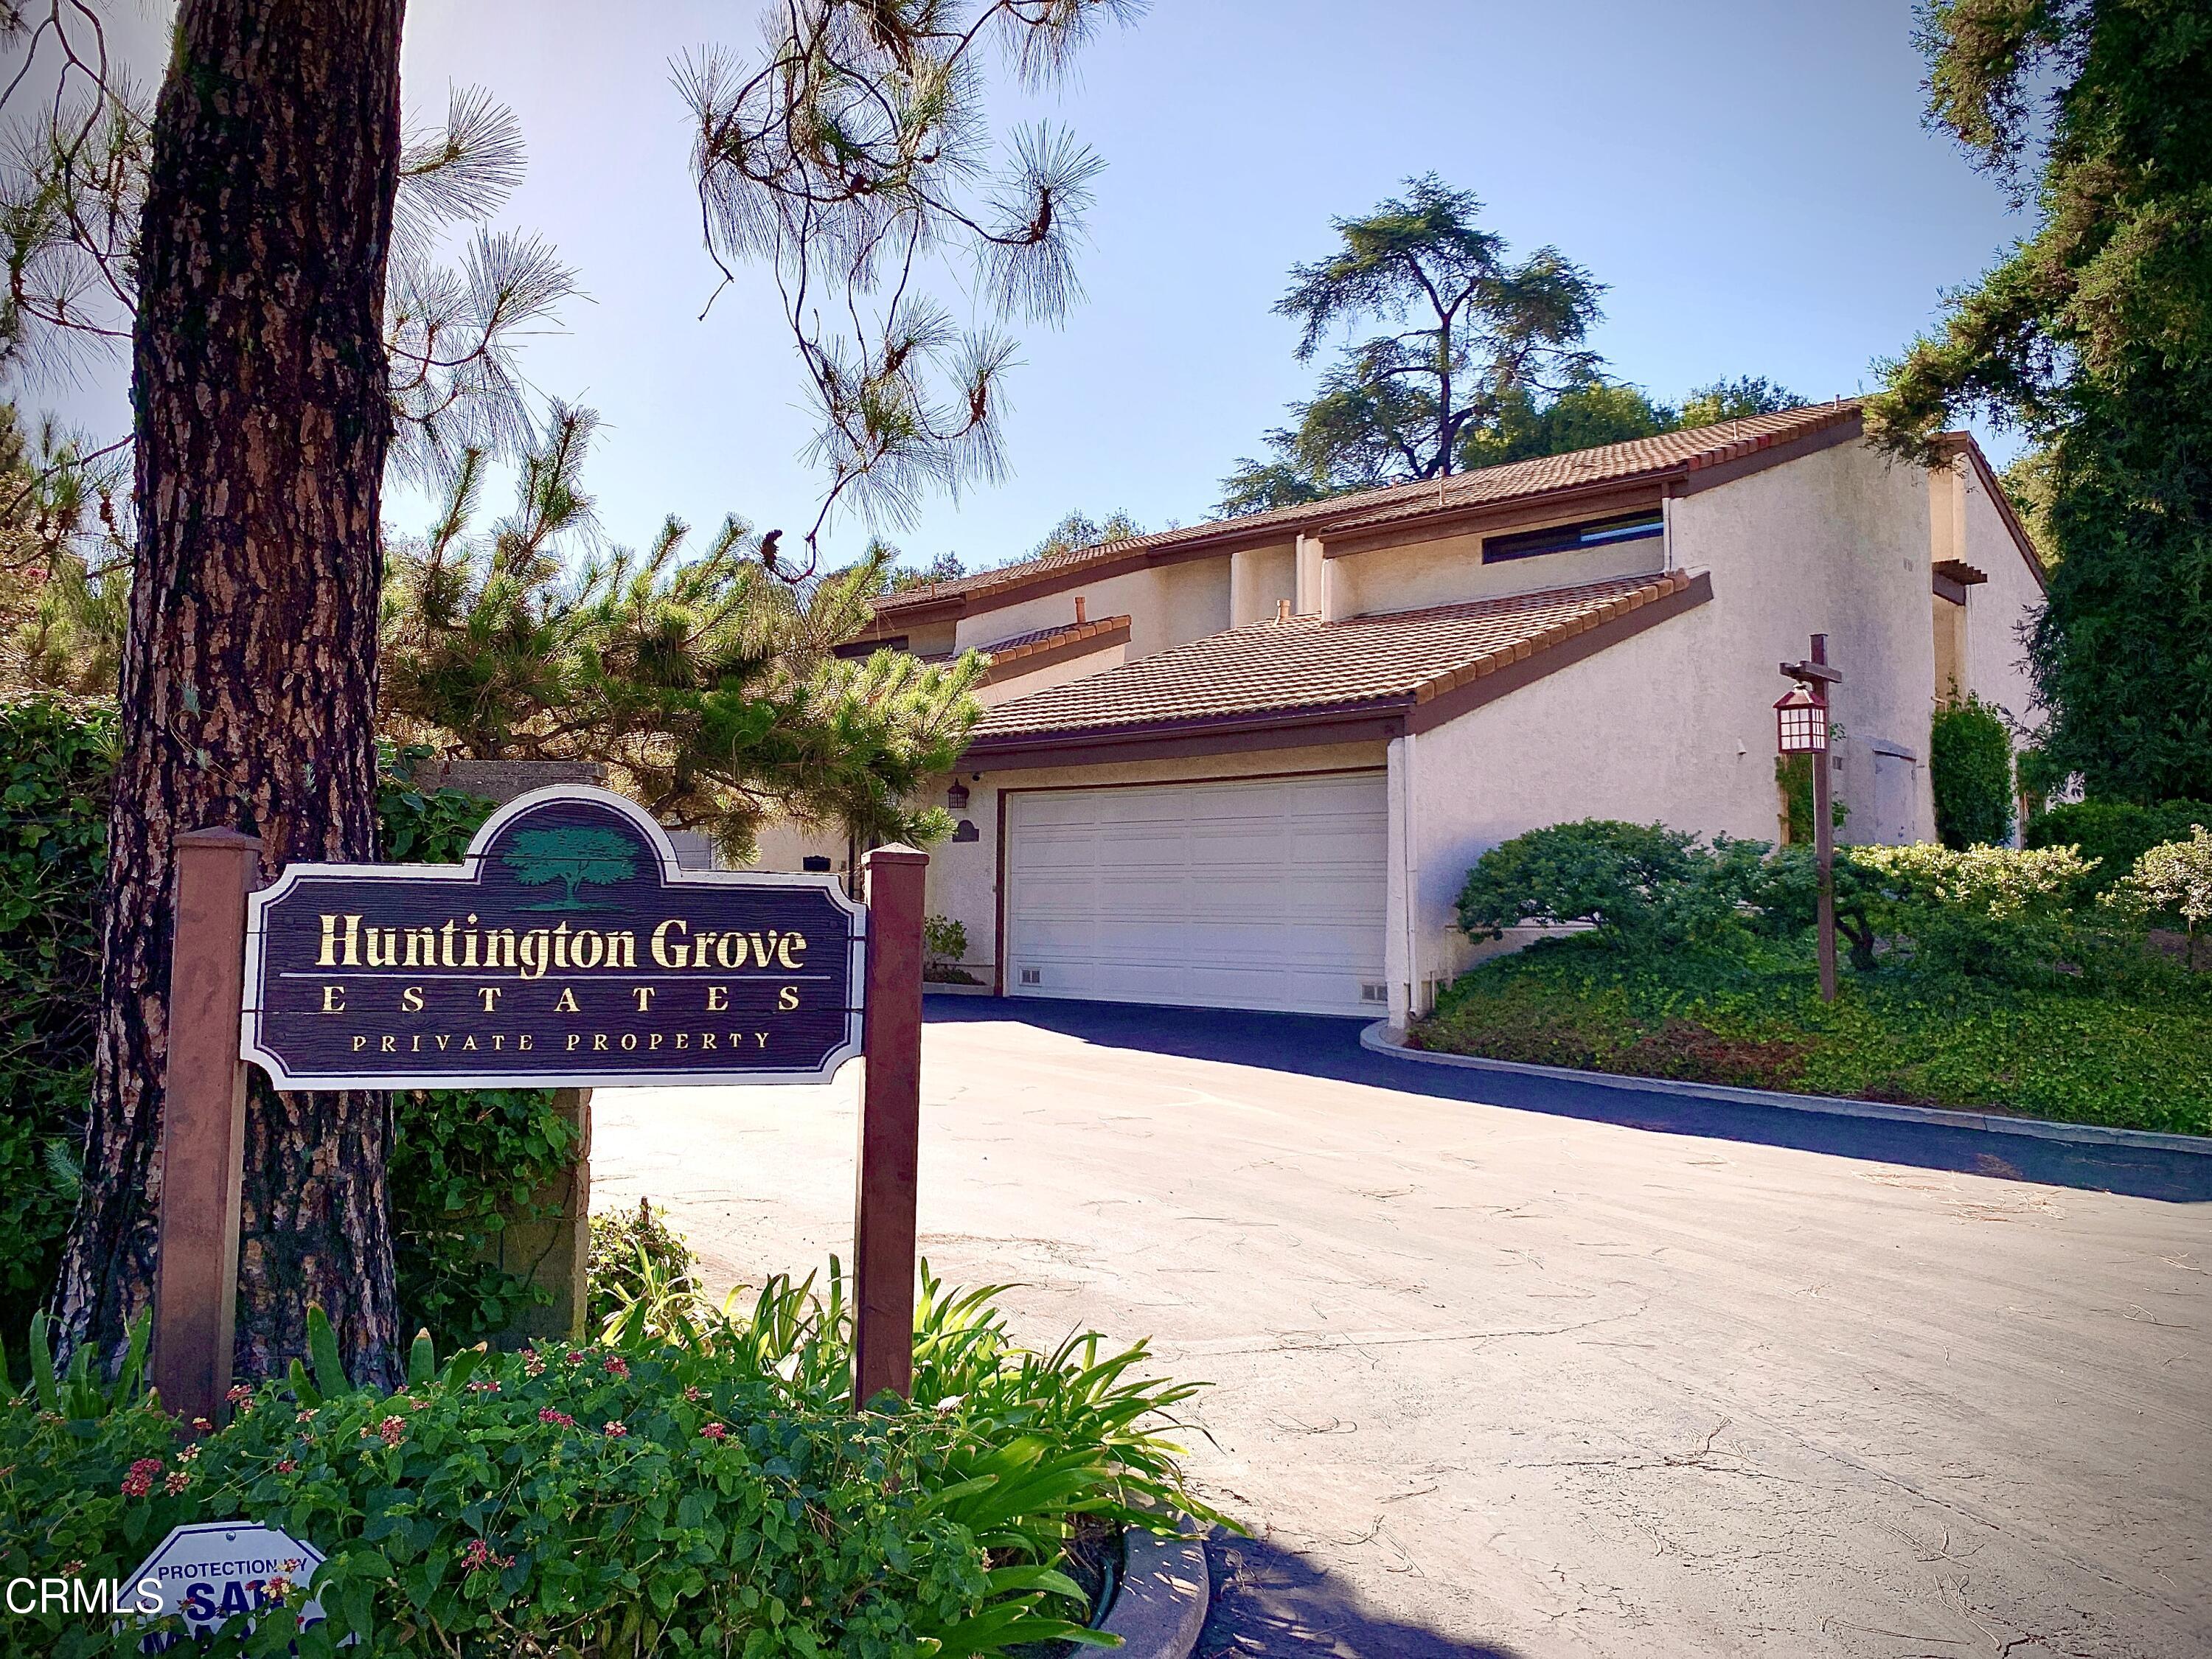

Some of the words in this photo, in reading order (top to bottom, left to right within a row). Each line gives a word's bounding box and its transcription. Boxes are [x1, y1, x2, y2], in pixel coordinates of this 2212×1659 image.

[316, 914, 637, 979] Huntington
[652, 919, 807, 969] Grove
[322, 986, 799, 1012] ESTATES
[353, 1035, 532, 1051] PRIVATE
[567, 1033, 769, 1050] PROPERTY
[158, 1559, 277, 1580] PROTECTION
